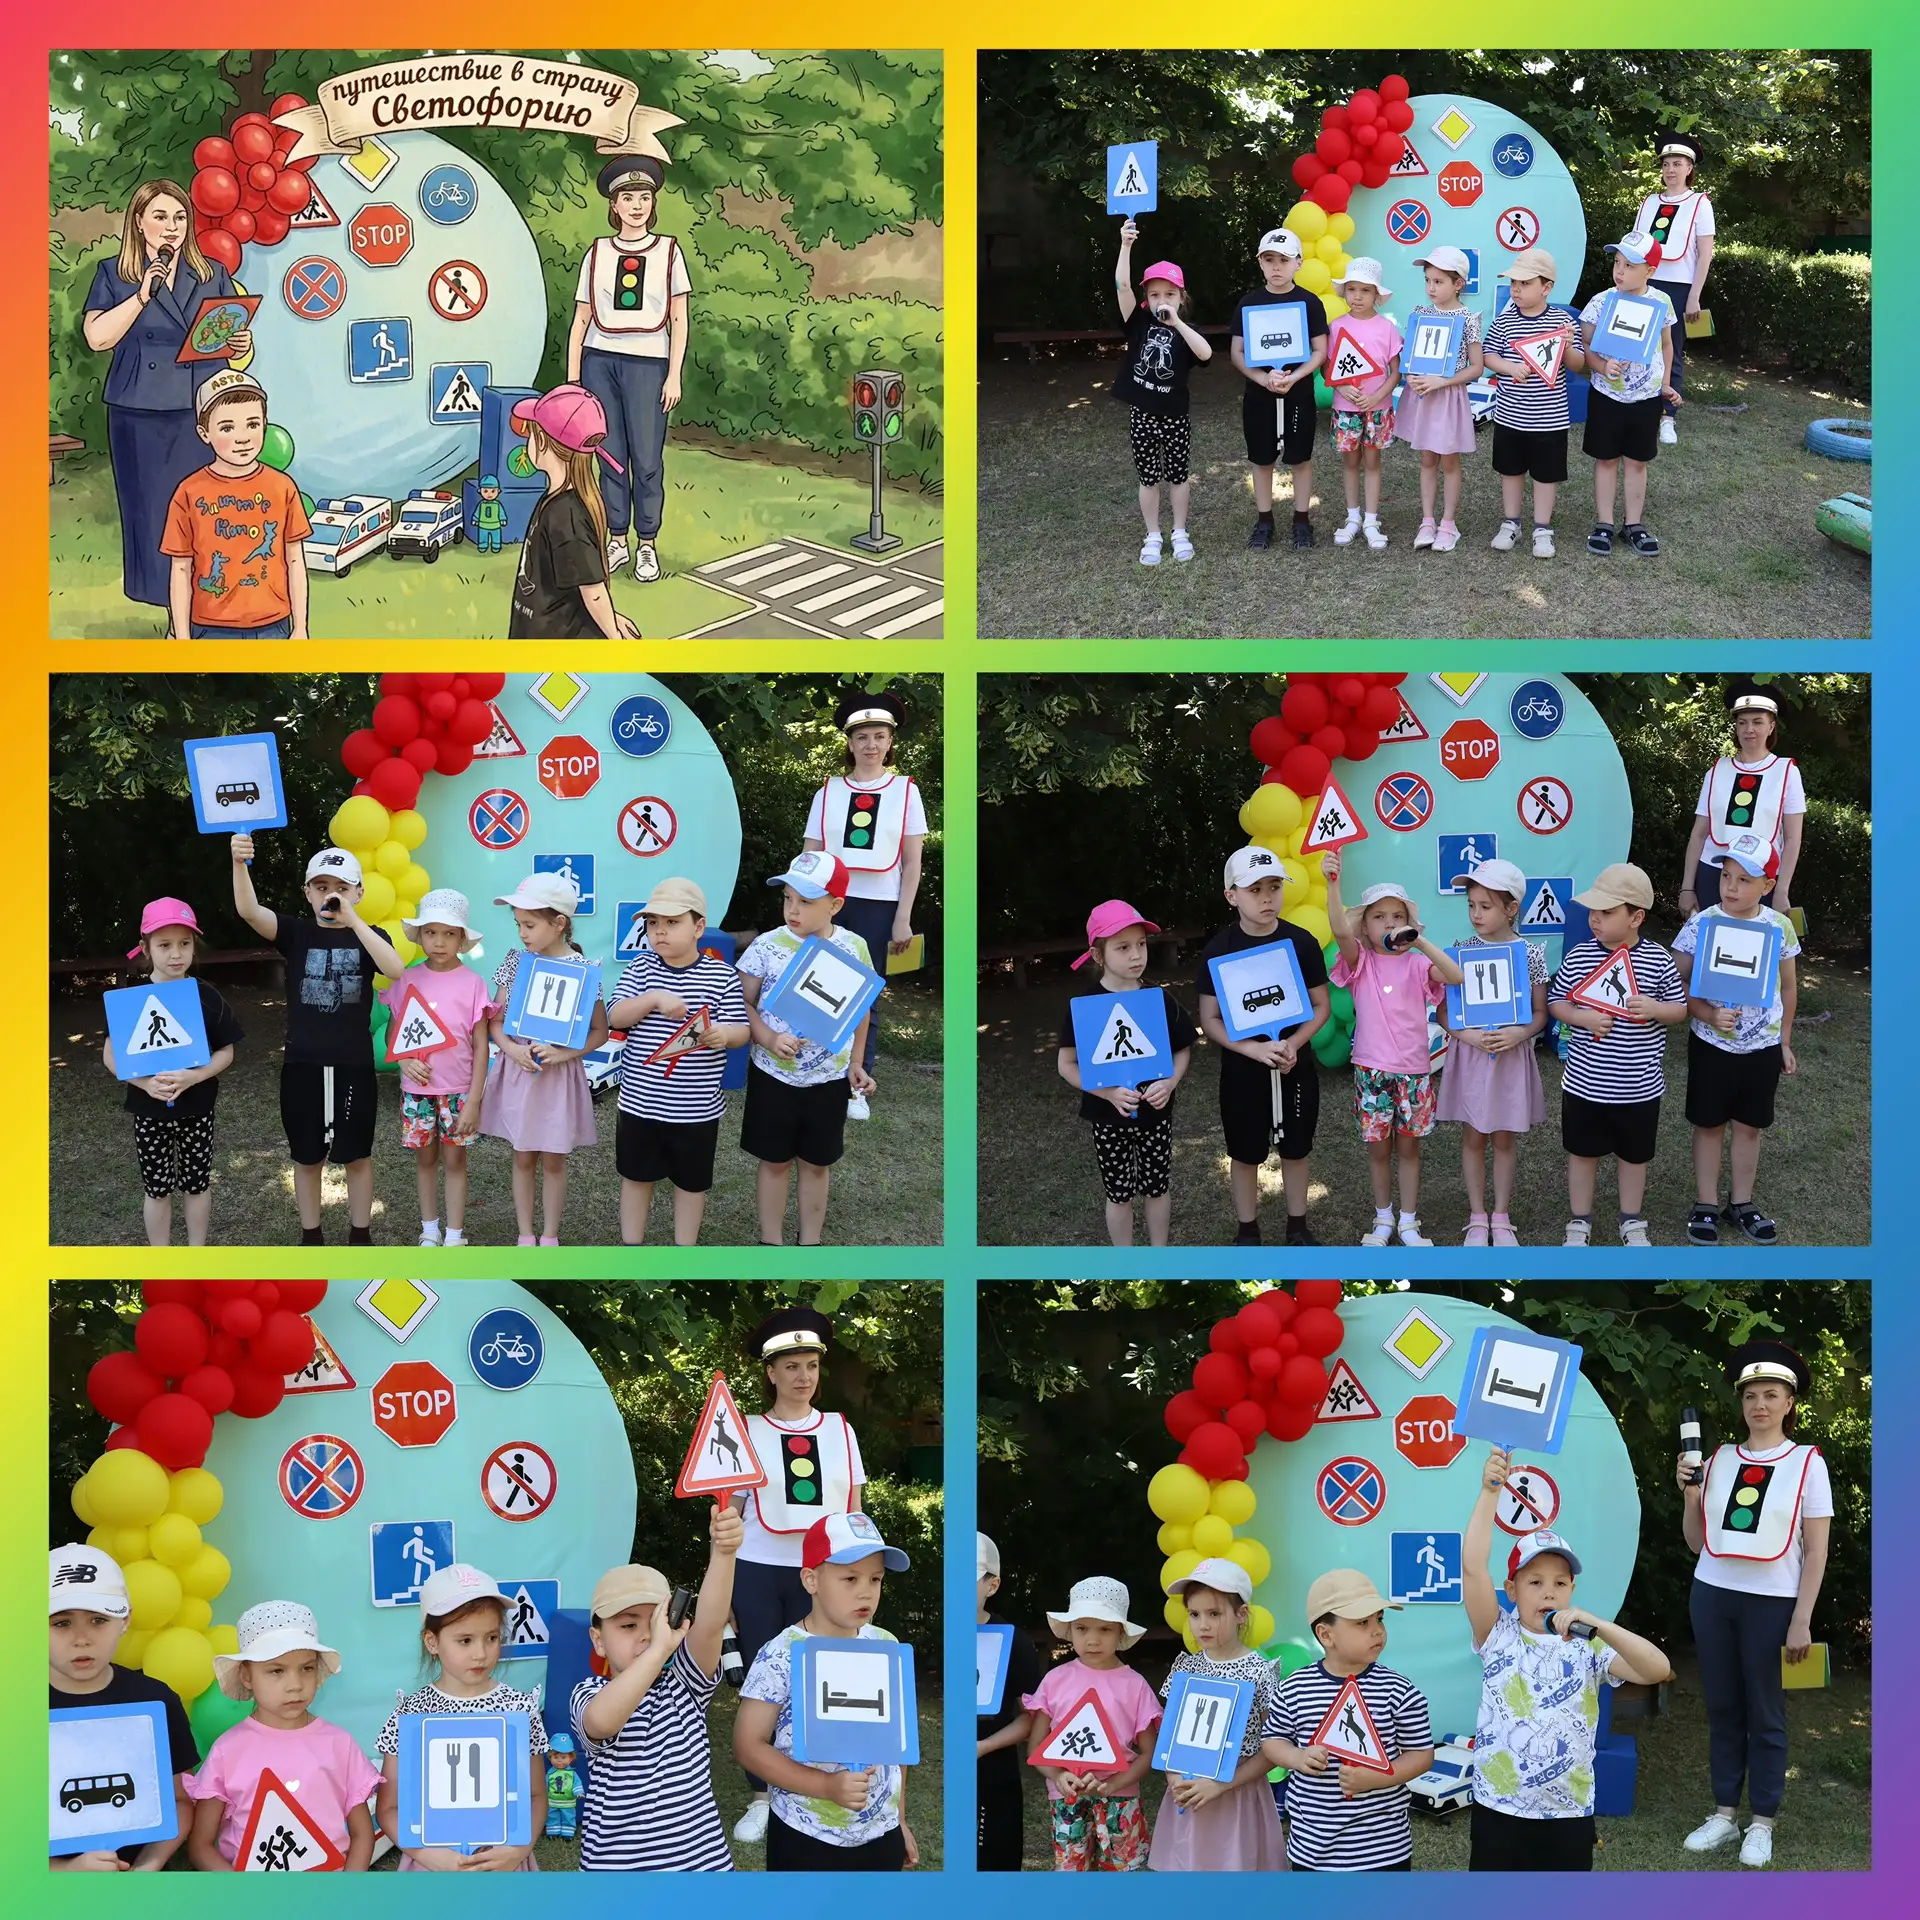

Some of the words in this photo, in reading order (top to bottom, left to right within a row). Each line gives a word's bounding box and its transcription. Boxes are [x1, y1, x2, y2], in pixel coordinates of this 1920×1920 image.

[332, 58, 503, 107] путешествие
[511, 60, 525, 82] в
[532, 68, 625, 108] страну
[372, 86, 593, 132] Светофорию
[1440, 176, 1481, 192] STOP
[355, 224, 407, 248] STOP
[1156, 385, 1171, 394] YOU
[1444, 738, 1497, 761] STOP
[542, 755, 597, 779] STOP
[378, 1389, 451, 1420] STOP
[1560, 1707, 1589, 1741] SPORT
[1420, 1775, 1442, 1783] 02
[1546, 1785, 1580, 1811] SPORT
